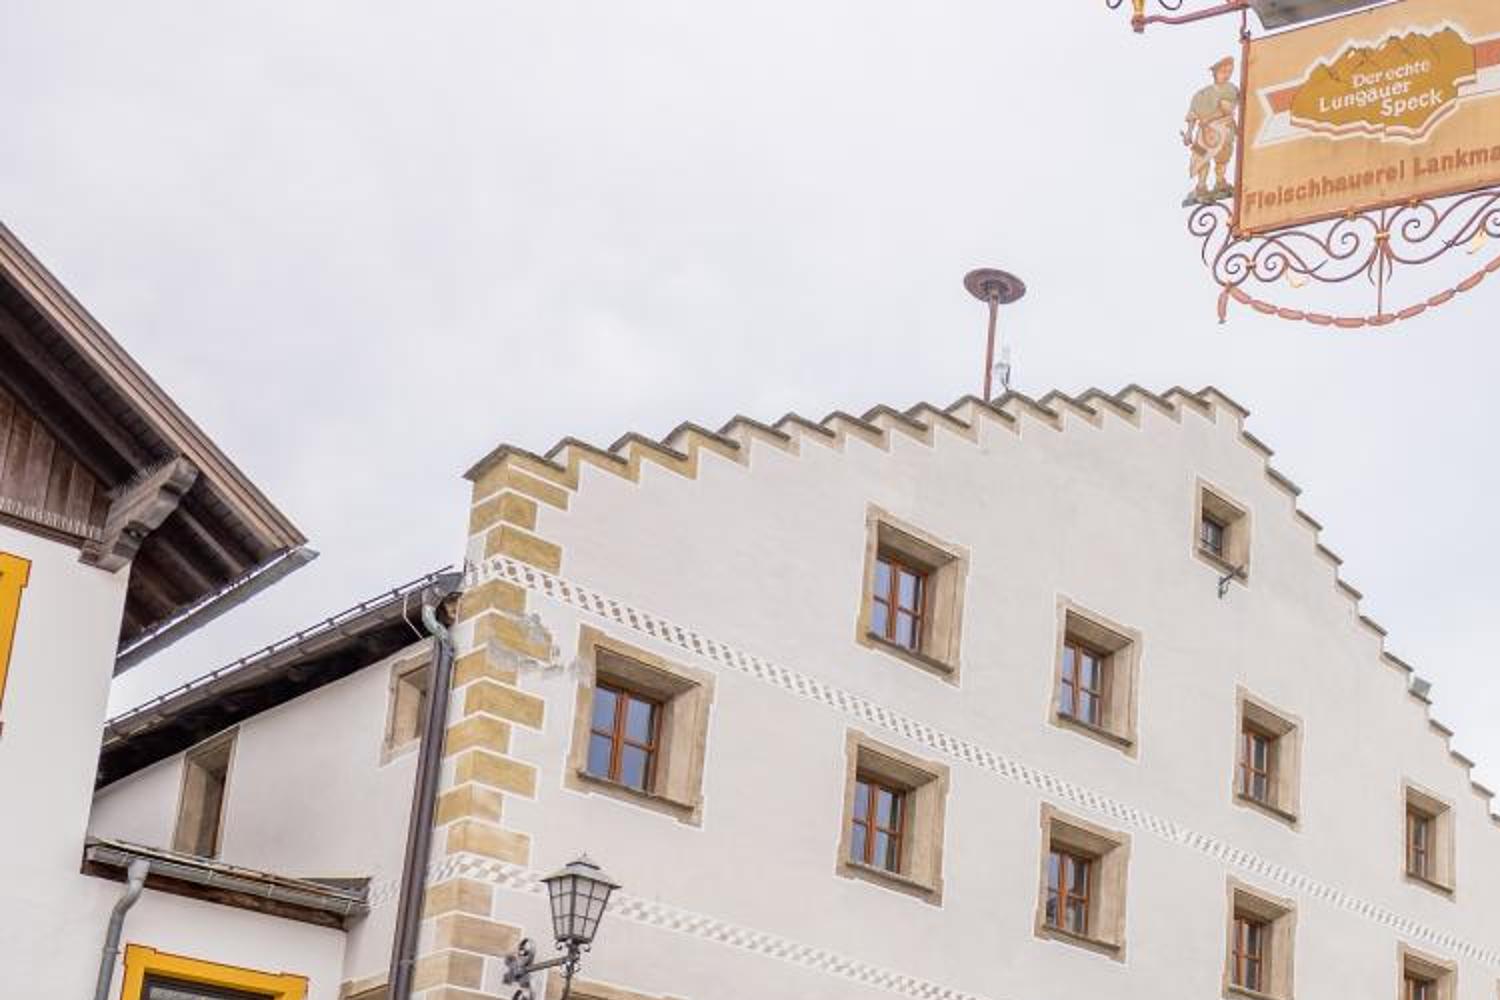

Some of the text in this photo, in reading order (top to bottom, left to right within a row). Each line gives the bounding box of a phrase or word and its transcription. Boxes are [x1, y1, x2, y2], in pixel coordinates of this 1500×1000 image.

[1352, 60, 1431, 88] Der echte
[1318, 81, 1411, 112] Lungauer
[1379, 88, 1443, 117] Speck
[1244, 162, 1405, 210] Fleischhauerei
